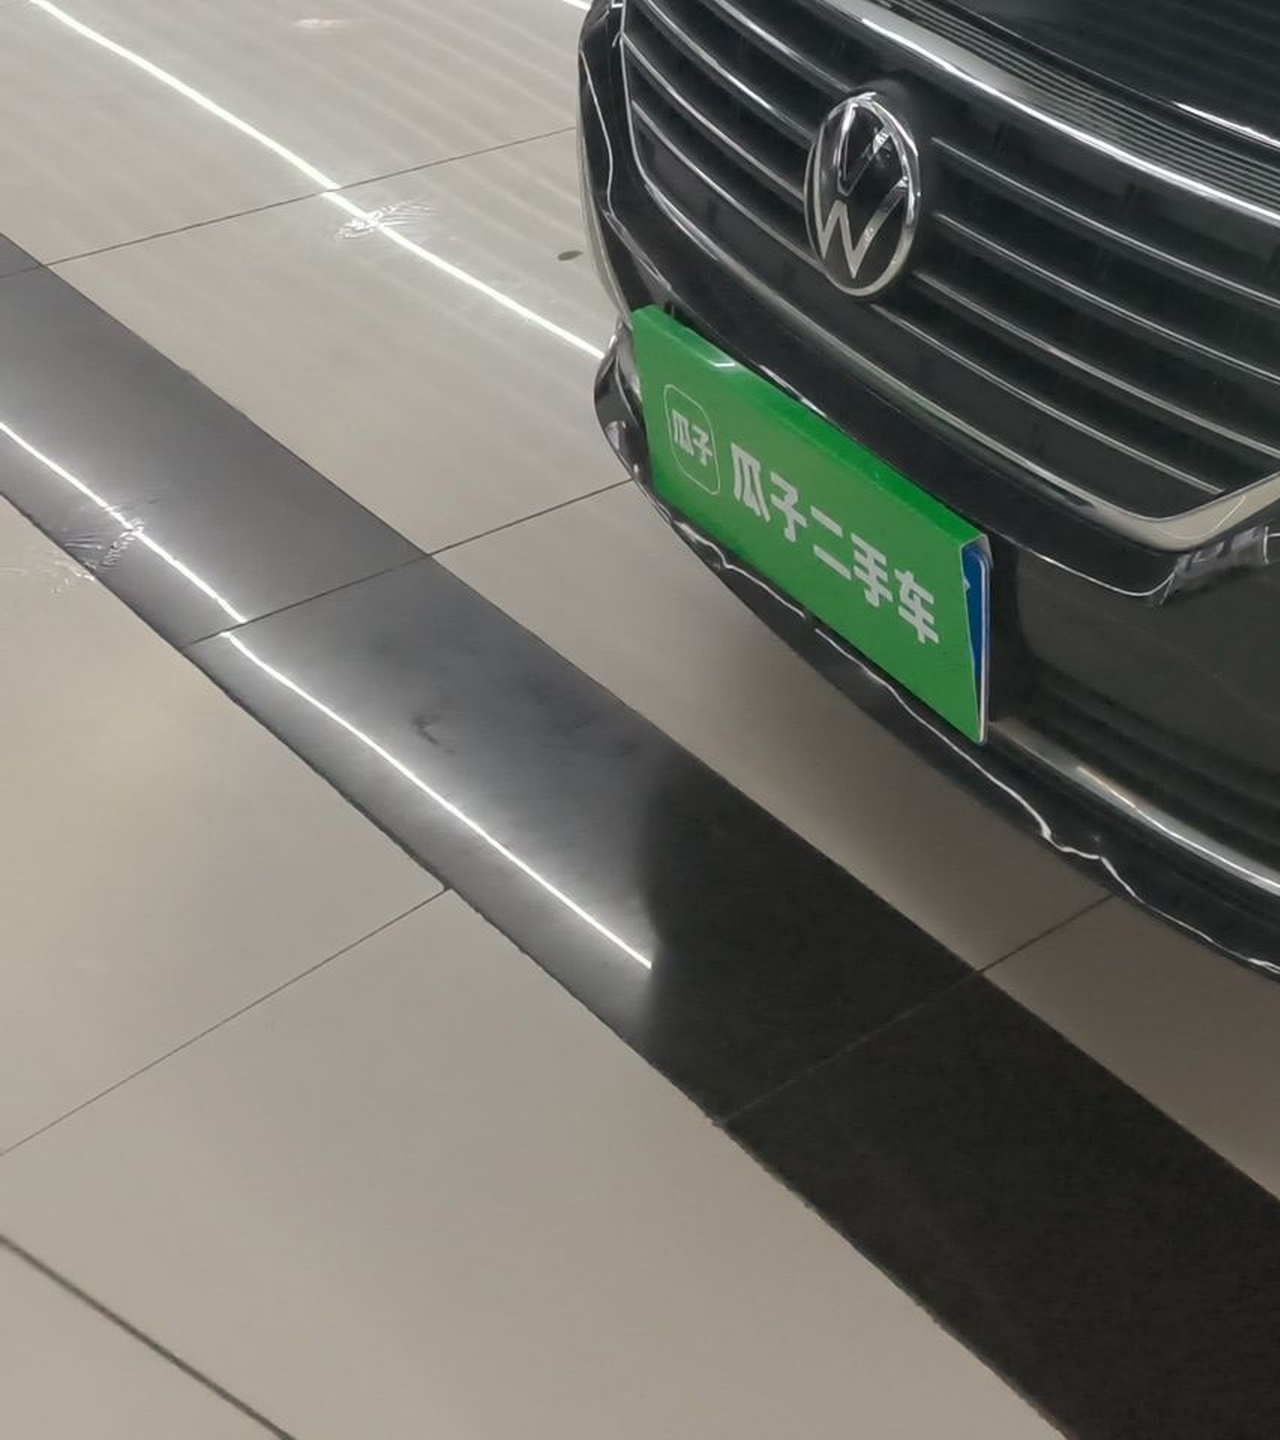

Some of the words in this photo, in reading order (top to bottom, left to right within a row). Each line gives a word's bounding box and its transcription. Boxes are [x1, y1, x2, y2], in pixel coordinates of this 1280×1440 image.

[672, 409, 713, 466] 瓜子
[731, 442, 940, 645] 瓜子二手车
